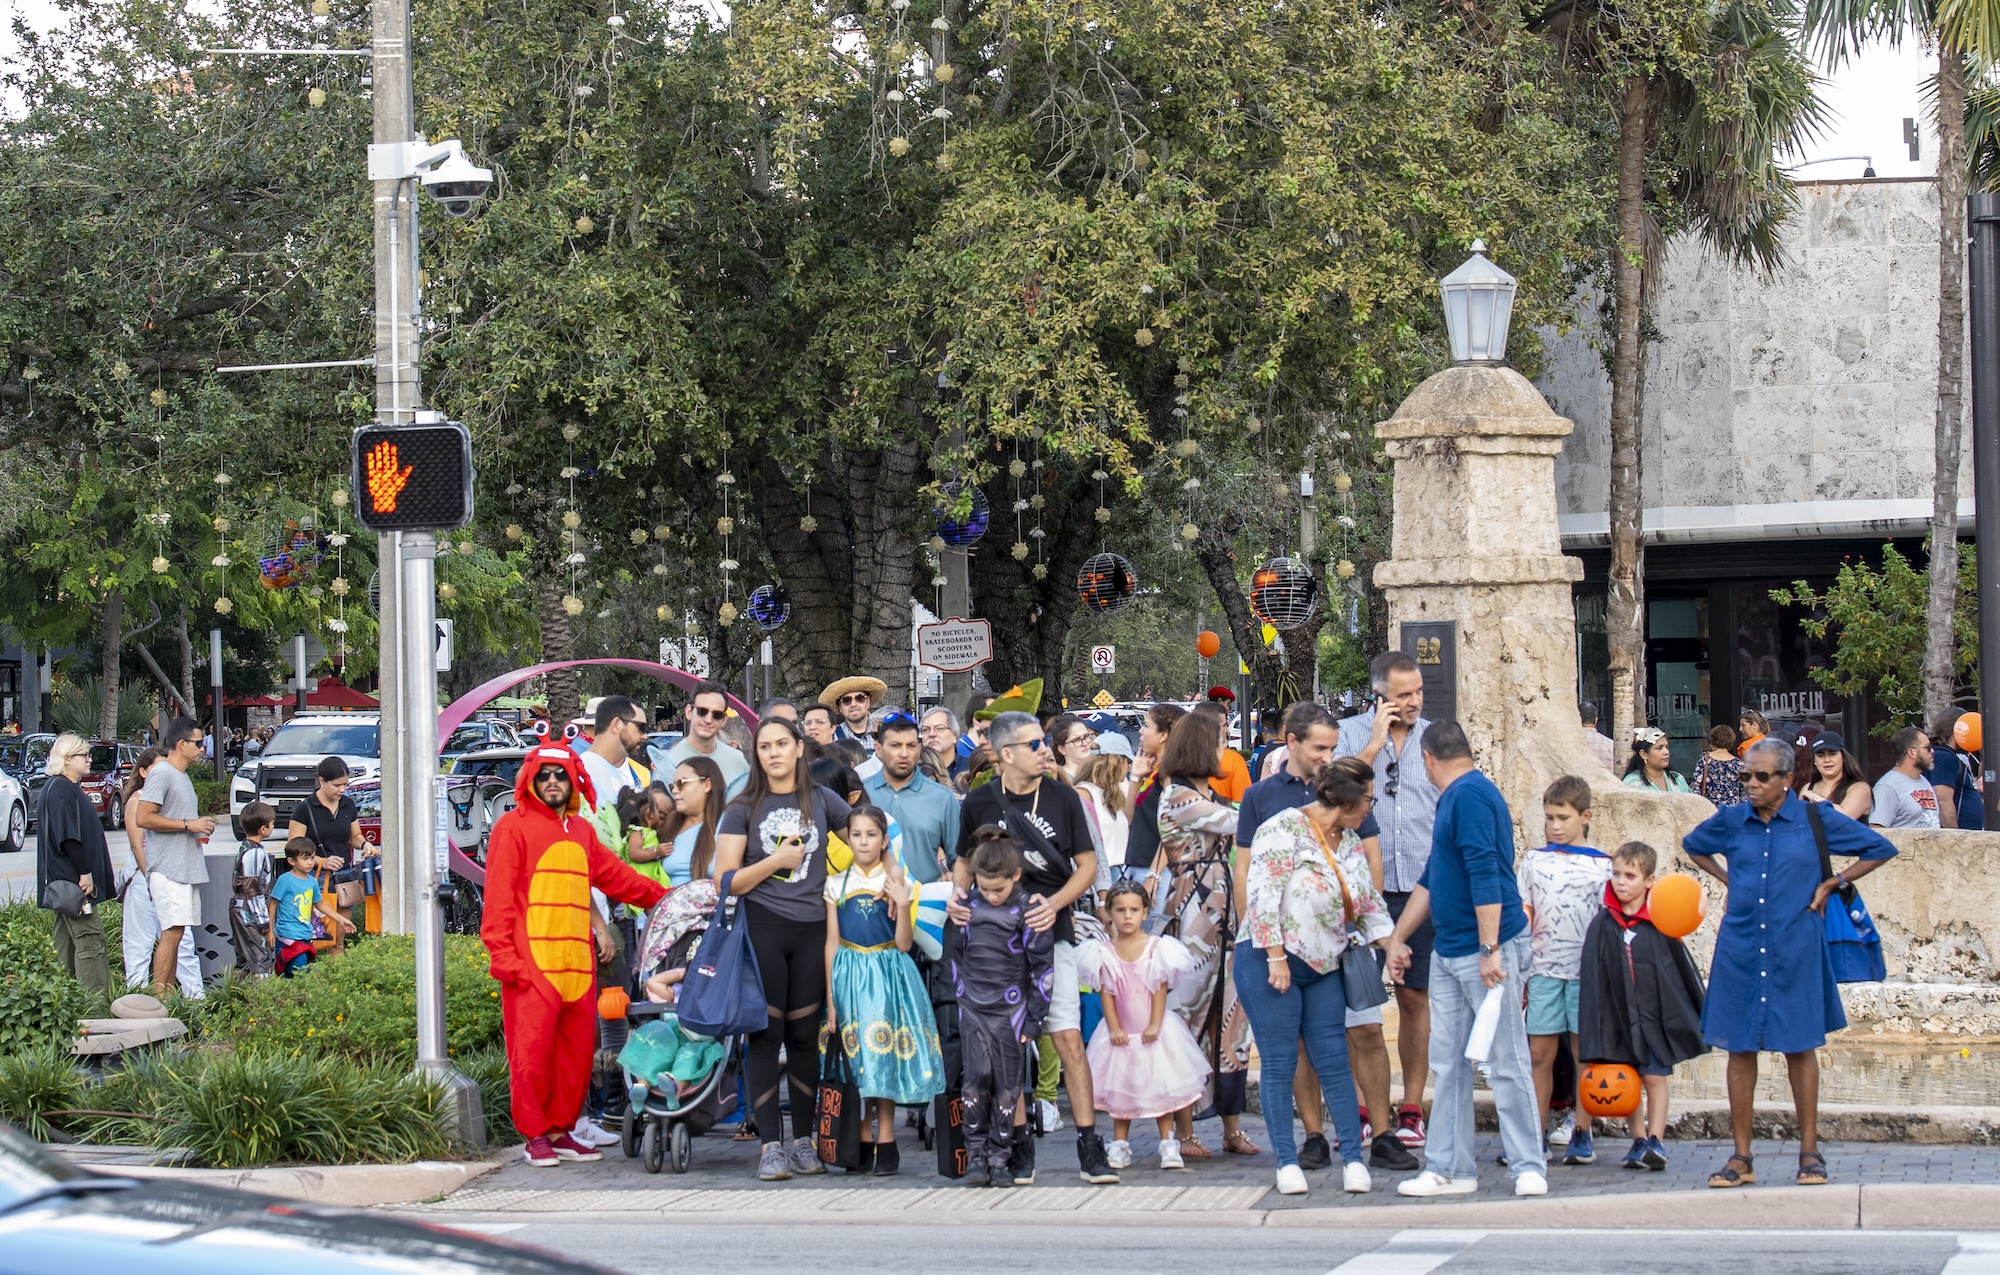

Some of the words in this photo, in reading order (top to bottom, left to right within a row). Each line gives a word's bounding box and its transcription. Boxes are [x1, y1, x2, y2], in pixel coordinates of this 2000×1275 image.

[943, 629, 977, 637] BICYCLES,
[925, 637, 972, 645] SKATEBOARDS
[937, 645, 973, 653] SCOOTERS
[944, 652, 978, 660] SIDEWALK
[1648, 695, 1692, 716] ROTEIN
[1760, 691, 1823, 712] PROTEIN
